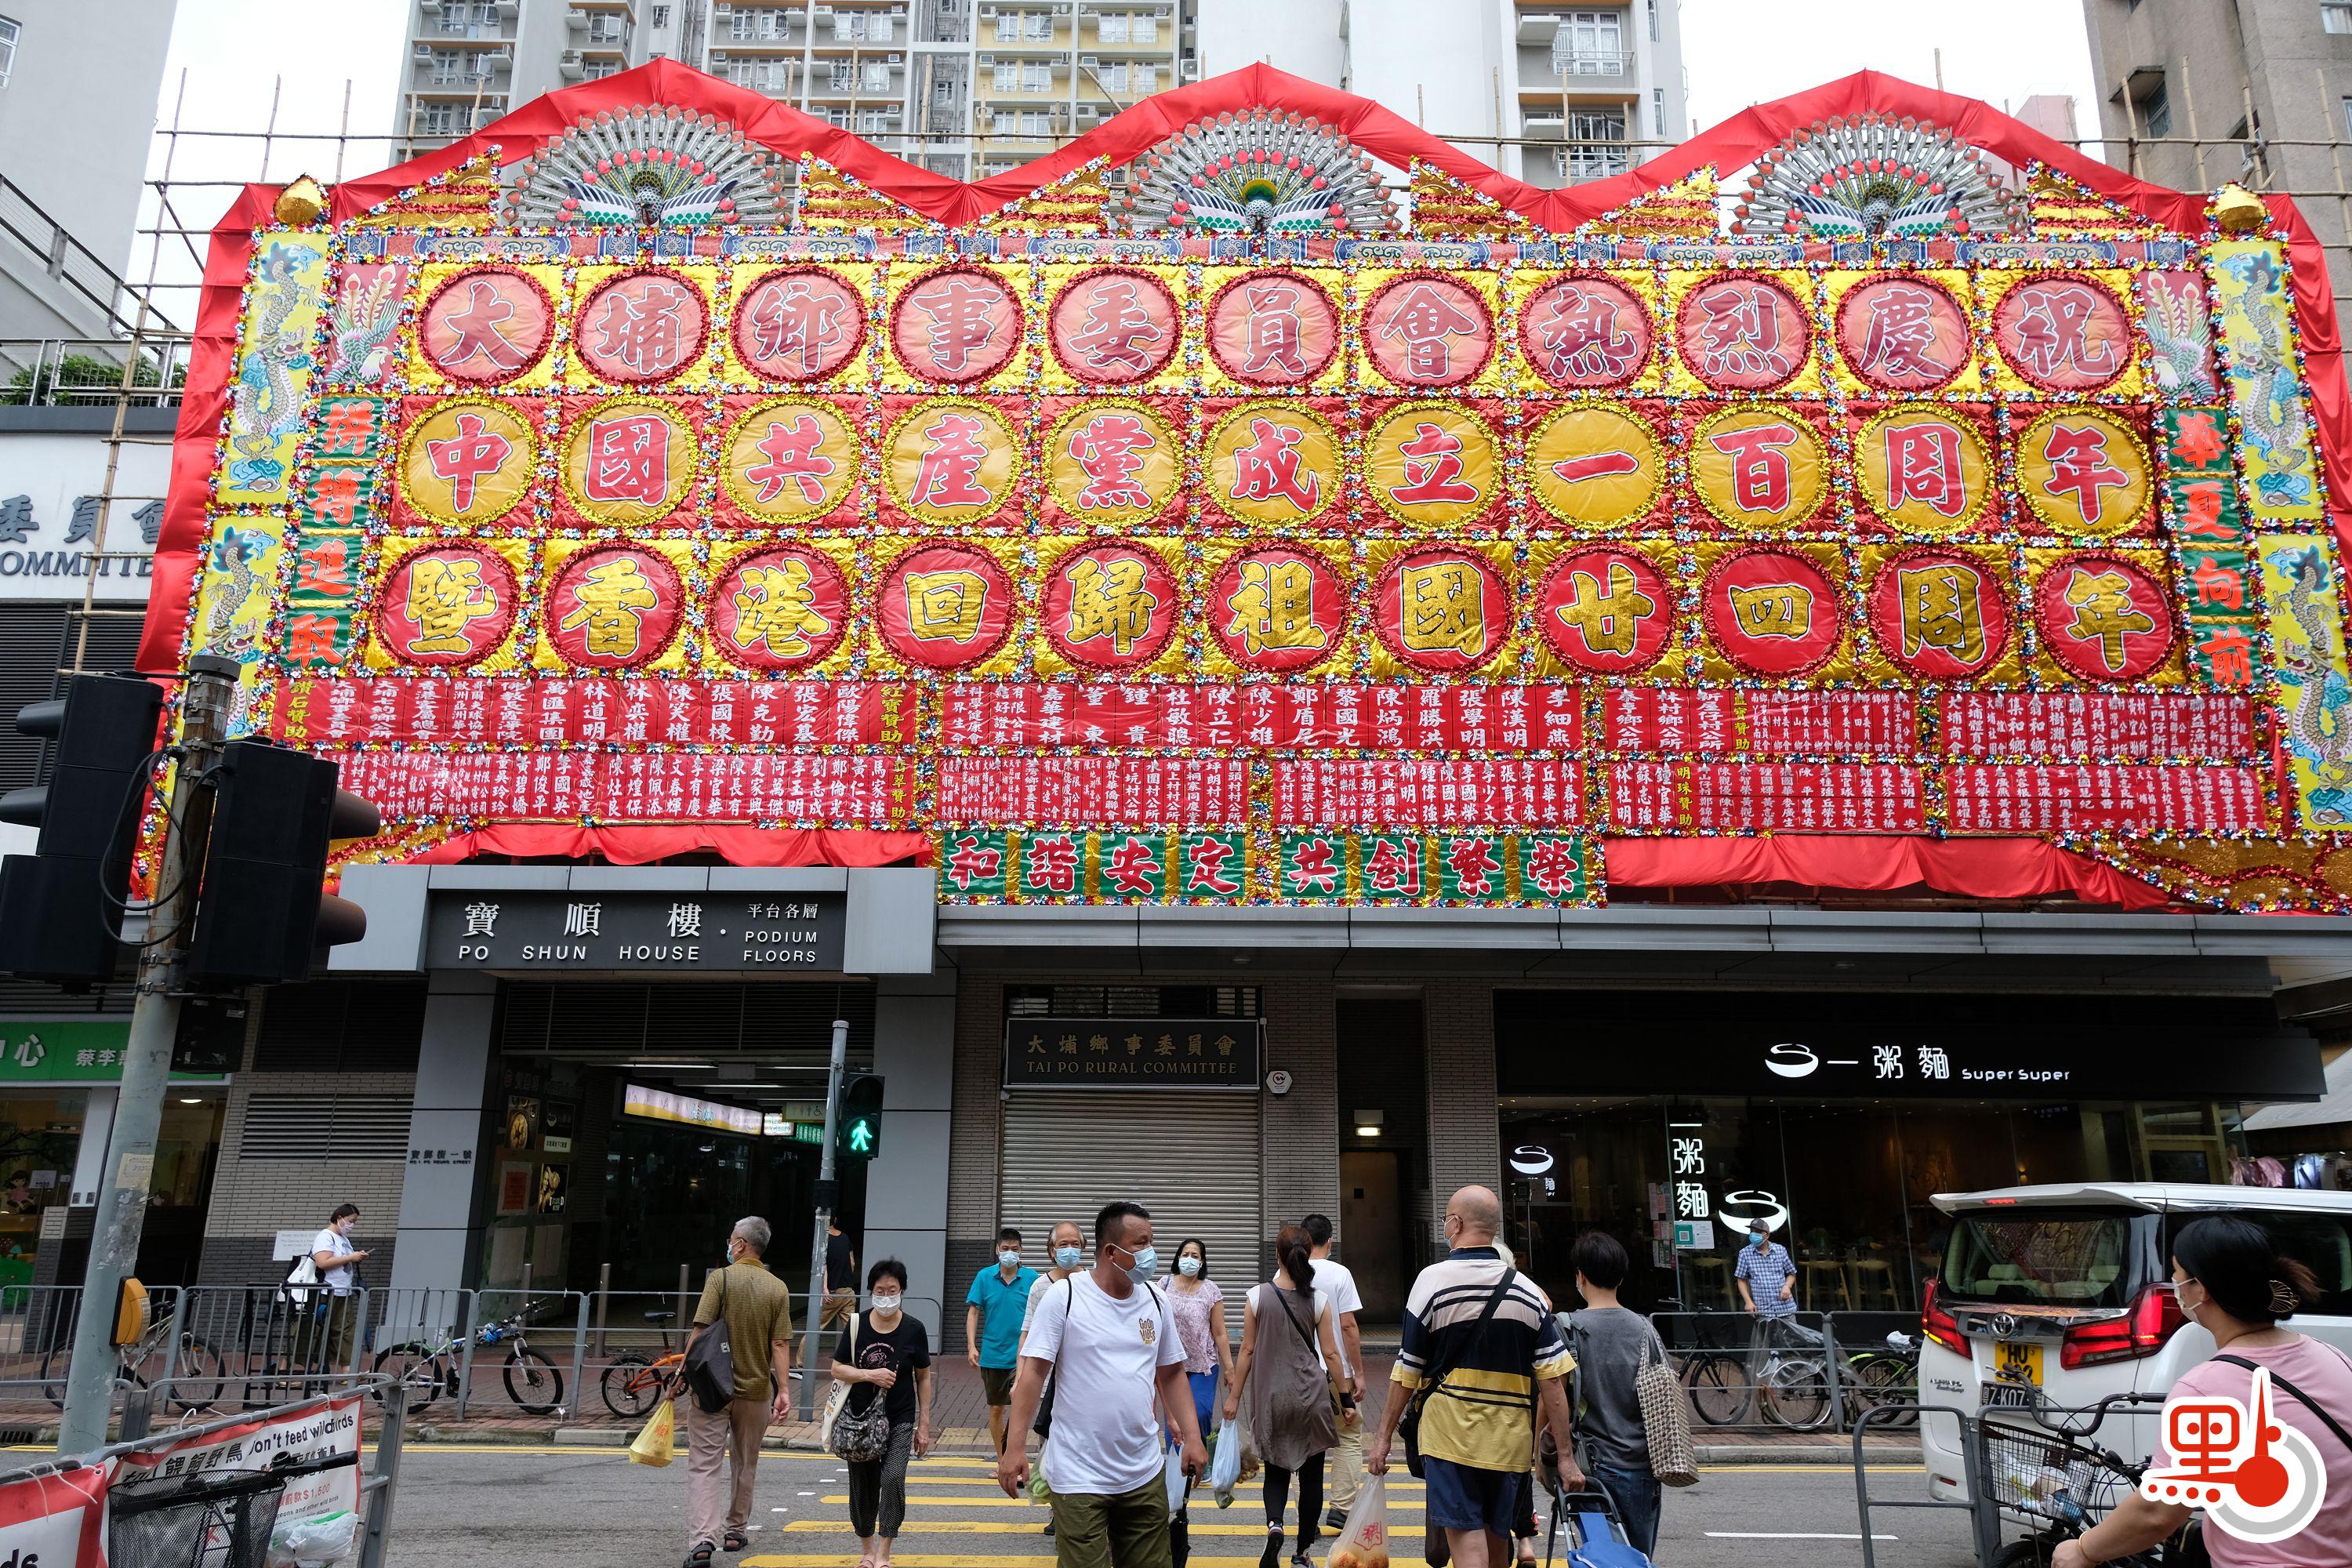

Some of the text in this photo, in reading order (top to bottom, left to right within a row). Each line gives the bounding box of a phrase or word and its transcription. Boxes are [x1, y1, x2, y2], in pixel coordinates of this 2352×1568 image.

[286, 401, 374, 669] 拼搏進取
[2170, 412, 2252, 684] 華夏向前
[539, 681, 568, 740] 萬匯集團
[583, 682, 612, 741] 林道明
[623, 683, 653, 742] 林奕權
[665, 683, 695, 742] 陳笑權
[750, 684, 779, 742] 陳克勤
[793, 684, 822, 743] 張宏基
[834, 685, 862, 743] 歐陽偉傑
[1011, 687, 1027, 744] 有限公司
[1038, 686, 1066, 745] 嘉華建材
[1166, 687, 1193, 746] 杜敏聰
[1208, 688, 1236, 746] 陳立仁
[1249, 688, 1277, 746] 陳少雄
[1334, 688, 1361, 746] 黎國光
[1376, 688, 1404, 746] 陳炳鴻
[1418, 688, 1446, 747] 羅勝洪
[1459, 689, 1486, 747] 張學明
[1501, 689, 1530, 747] 陳漢明
[1544, 689, 1572, 748] 李細燕
[532, 756, 552, 815] 鄭俊平
[607, 758, 625, 817] 陳灶良
[626, 757, 646, 817] 黃煌保
[666, 759, 685, 817] 文春輝
[728, 758, 747, 817] 陳長有
[746, 758, 765, 817] 夏家興
[787, 759, 806, 818] 李玉明
[850, 758, 868, 818] 黃仁生
[869, 759, 887, 818] 馬家強
[1380, 763, 1397, 822] 文興酒家
[1439, 764, 1457, 822] 陳國英
[1460, 764, 1479, 822] 李國榮
[1480, 764, 1499, 823] 李少文
[1541, 764, 1559, 822] 丘華安
[1616, 764, 1633, 824] 林杜明
[948, 835, 1240, 895] 和諧安定
[1288, 837, 1580, 898] 共創繁榮
[462, 902, 702, 938] 寶順樓
[745, 931, 818, 943] PODIUM
[747, 902, 818, 920] 平台各層
[459, 946, 700, 961] PO SHUN HOUSE
[743, 949, 817, 963] FLOORS
[1027, 1034, 1236, 1056] 大埔鄉事委員會
[1027, 1062, 1237, 1074] TAI PO RURAL COMMITTEE
[285, 1425, 308, 1445] feed
